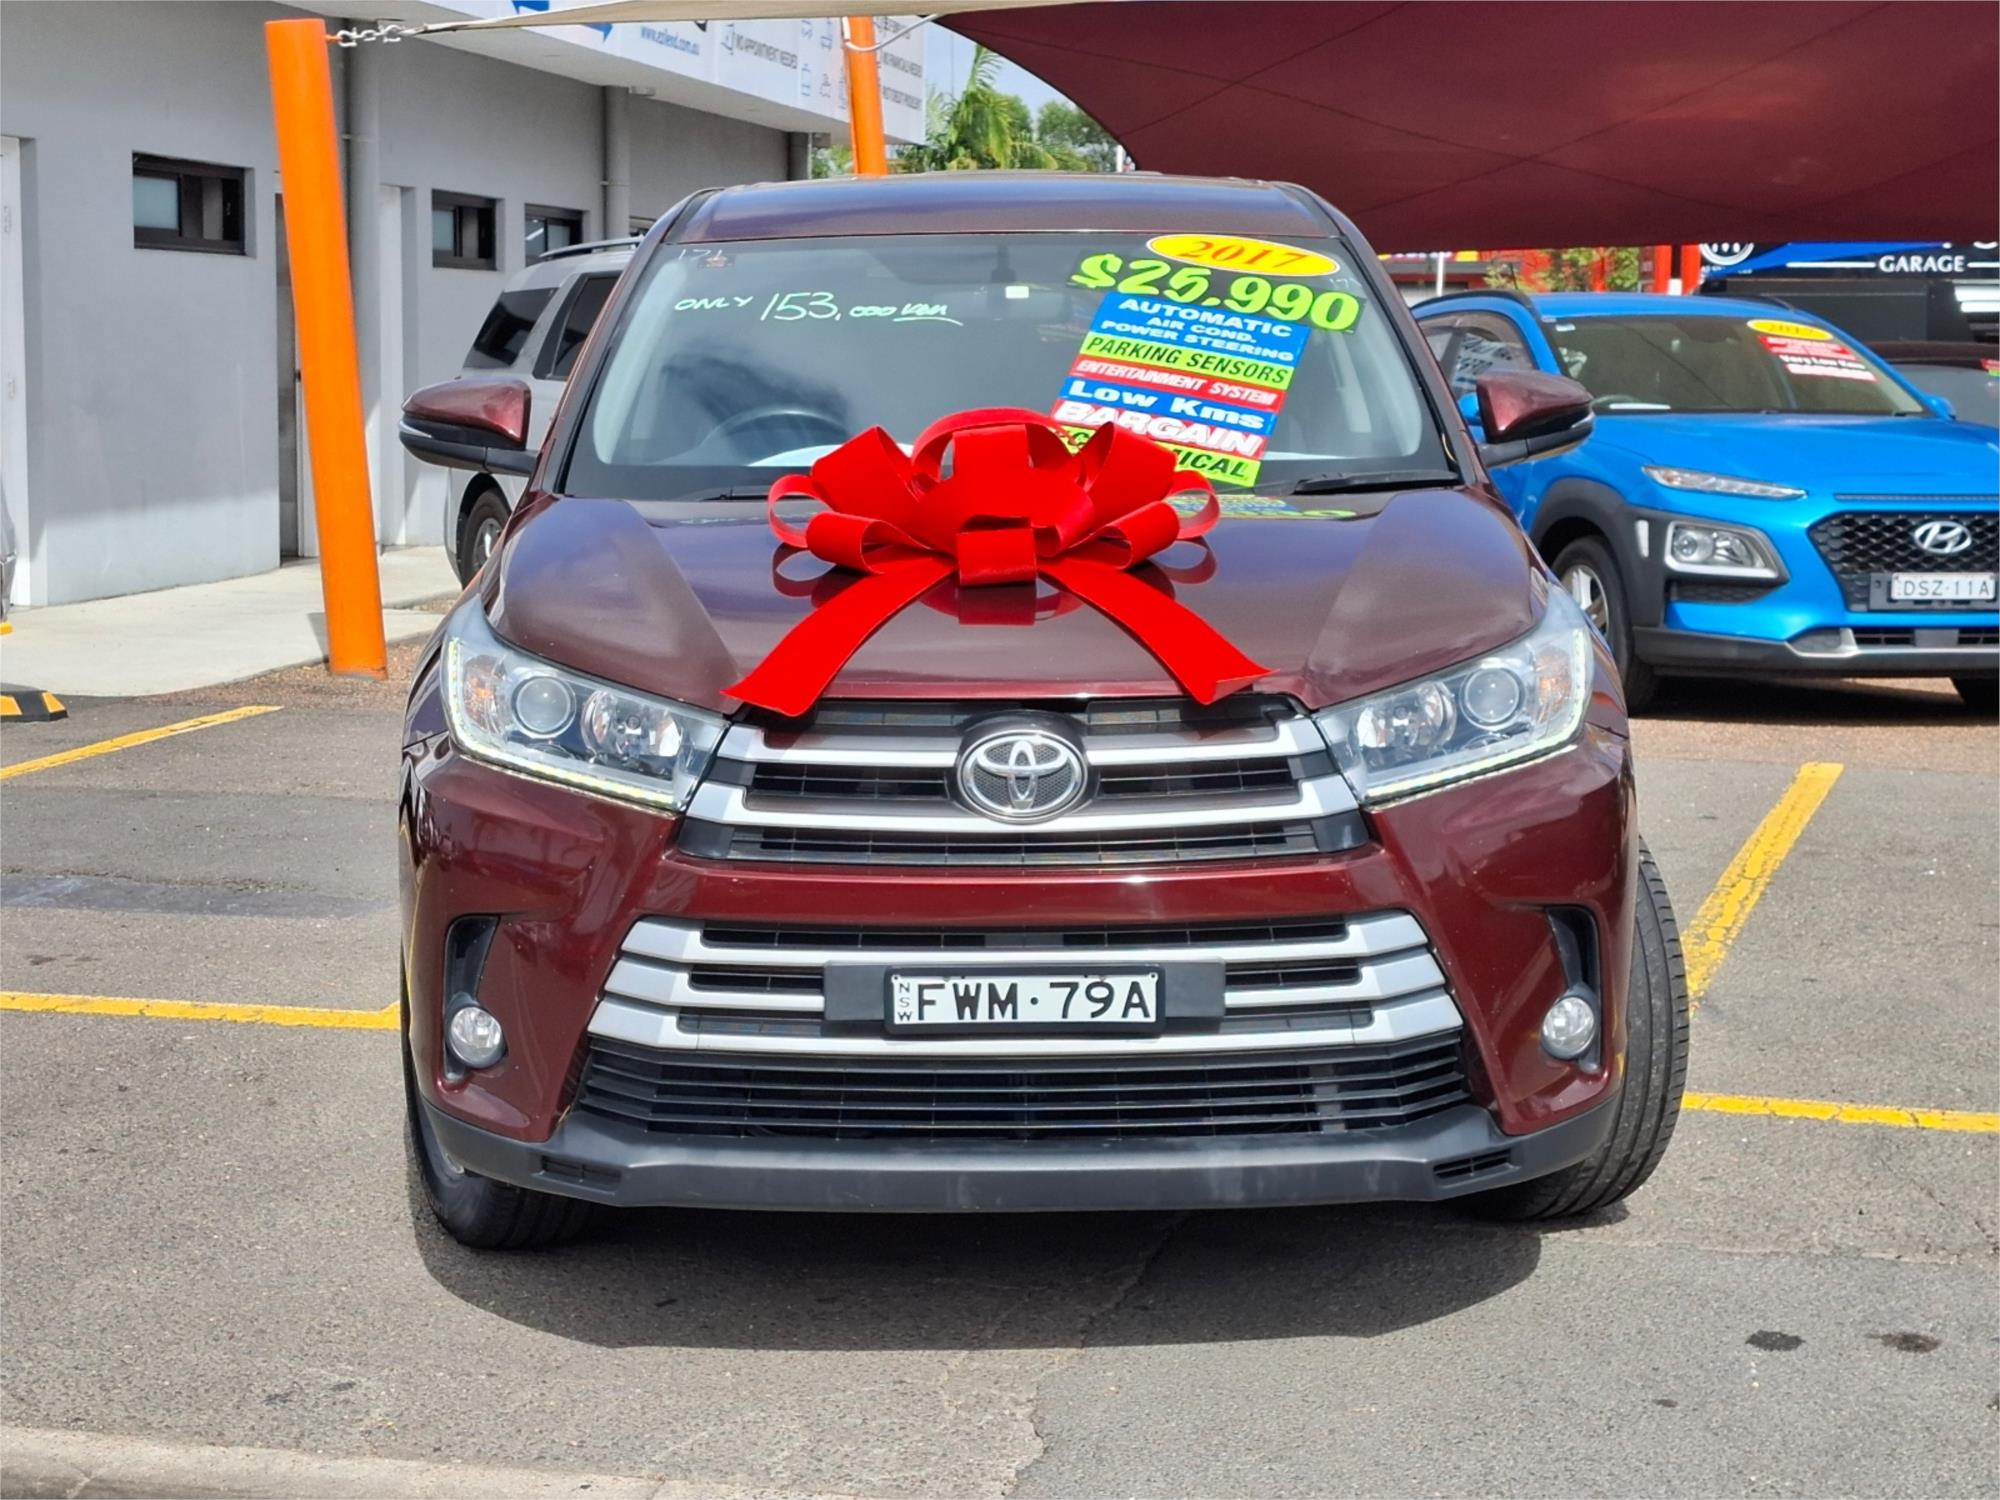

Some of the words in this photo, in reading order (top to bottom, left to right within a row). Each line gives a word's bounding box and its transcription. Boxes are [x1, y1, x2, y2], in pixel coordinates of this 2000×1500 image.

[1178, 240, 1309, 269] 2017
[1878, 254, 1966, 273] GARAGE
[674, 296, 754, 312] ONLY
[1117, 298, 1294, 338] AUTOMATIC
[1100, 319, 1179, 341] POWER
[1183, 334, 1295, 362] STEERING
[1146, 316, 1186, 331] AIR
[1190, 323, 1258, 344] COND.
[1086, 336, 1183, 365] PARKING
[1186, 352, 1290, 385] SENSORS
[1075, 359, 1207, 391] ENTERTAINMENT
[1208, 382, 1279, 406] SYSTEM
[1053, 400, 1264, 457] BARGAIN
[1169, 397, 1265, 430] Kms
